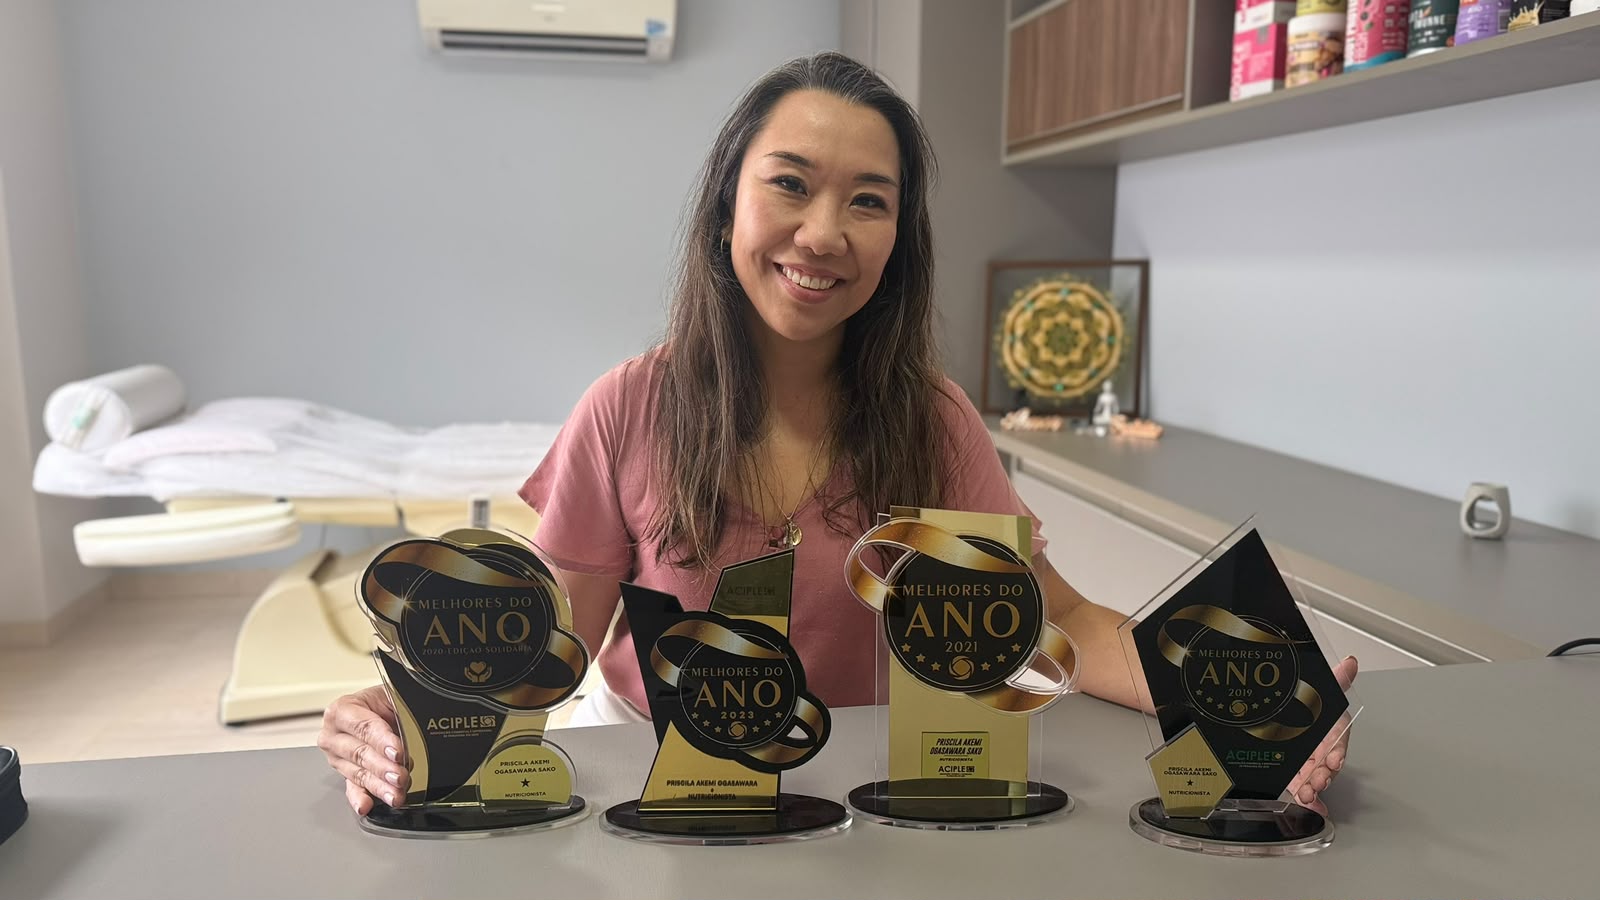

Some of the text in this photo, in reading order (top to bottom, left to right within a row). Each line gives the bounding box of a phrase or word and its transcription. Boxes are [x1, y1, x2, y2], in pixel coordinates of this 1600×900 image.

[902, 584, 1024, 597] MELHORES DO
[418, 596, 532, 610] MELHORES DO
[904, 600, 1021, 639] ANO
[423, 611, 531, 646] ANO
[944, 641, 978, 653] 2021
[1198, 649, 1283, 660] MELHORES DO
[691, 666, 784, 677] MELHORES DO
[1200, 661, 1280, 687] ANO
[694, 679, 782, 708] ANO
[1228, 688, 1253, 697] 2019
[720, 711, 755, 720] 2023
[427, 716, 478, 730] ACIPLE
[936, 738, 982, 746] PRISCILA AKEMI
[967, 747, 983, 755] SAKO
[1225, 750, 1270, 761] ACIPLE
[494, 767, 538, 775] OGASAWARA
